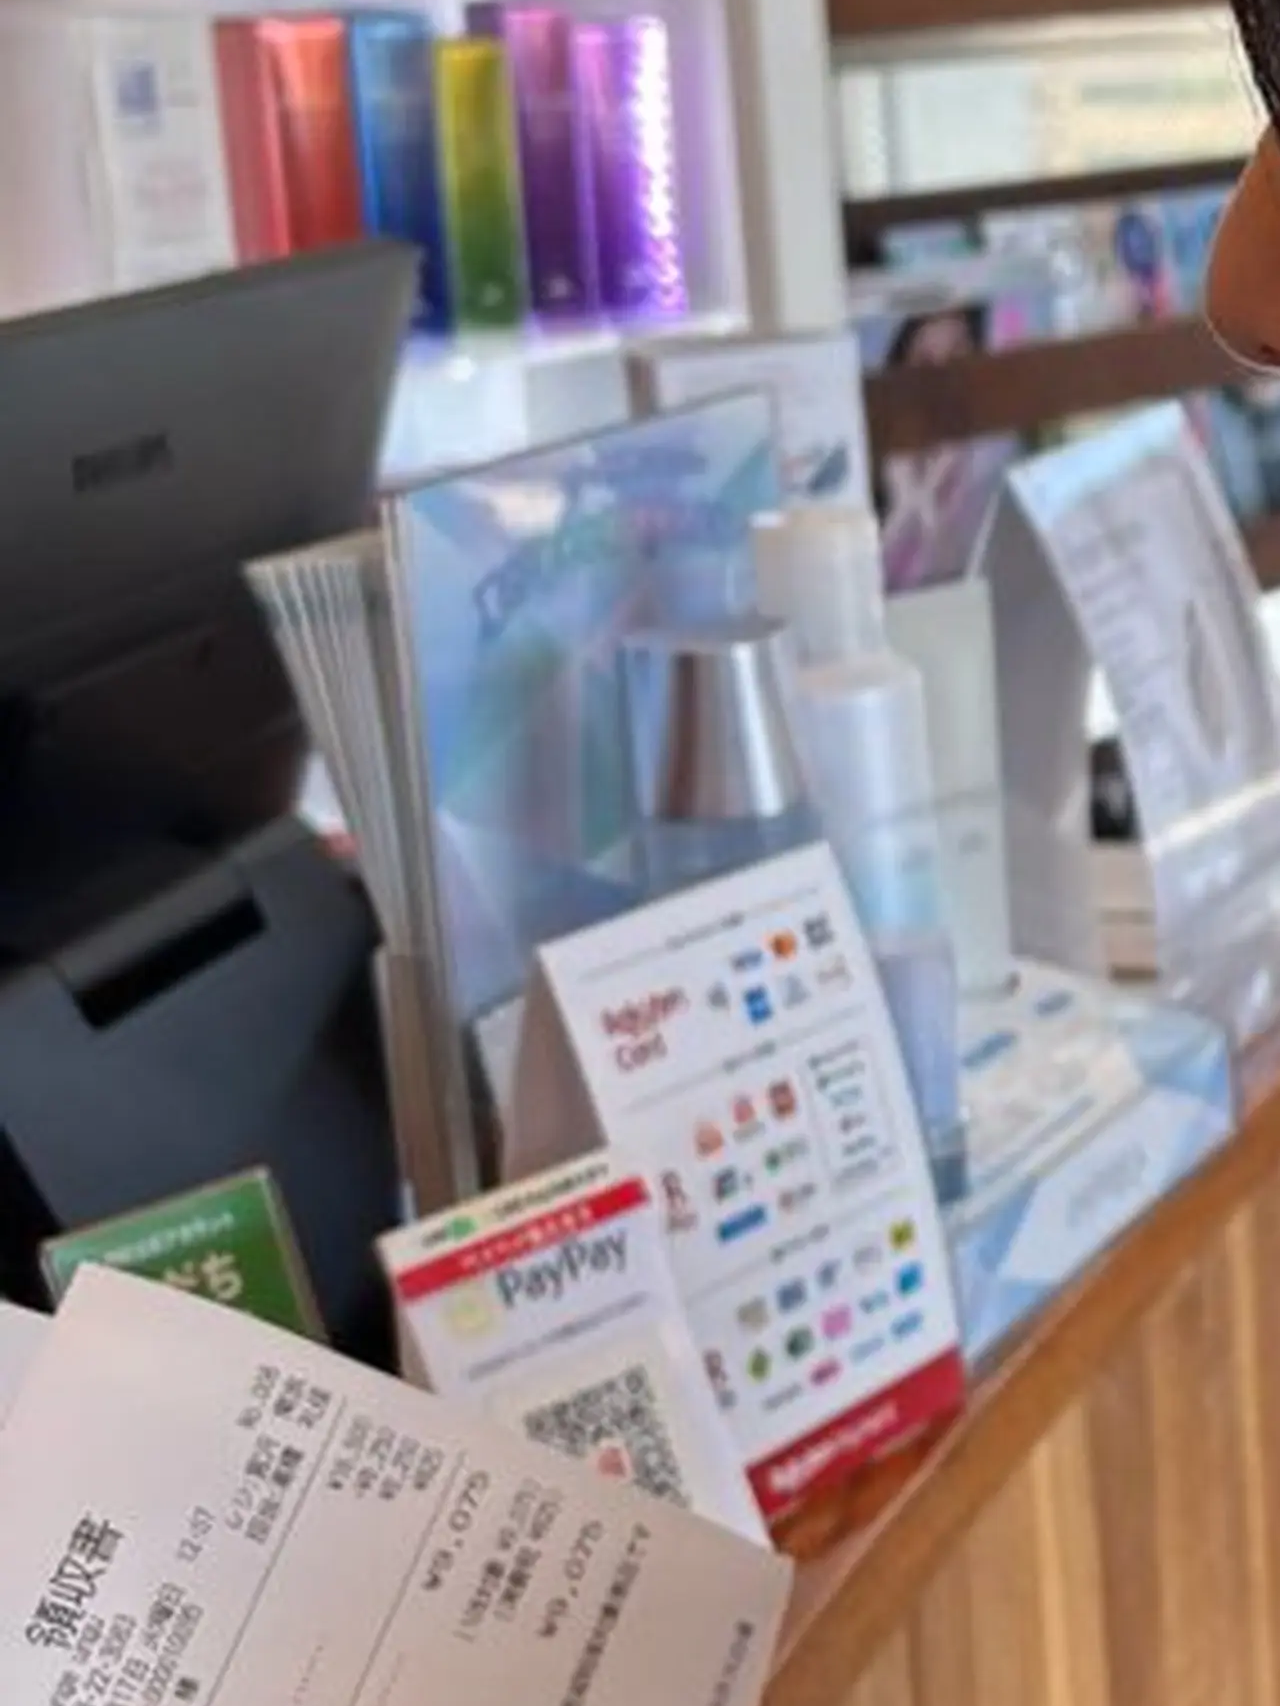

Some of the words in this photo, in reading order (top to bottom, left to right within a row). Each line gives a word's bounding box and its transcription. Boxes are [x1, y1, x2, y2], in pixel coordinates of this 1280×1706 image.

[497, 1227, 630, 1310] PayPay
[25, 1513, 124, 1650] 領収書
[422, 1470, 490, 1591] ¥9,075
[537, 1520, 604, 1638] ¥9,075
